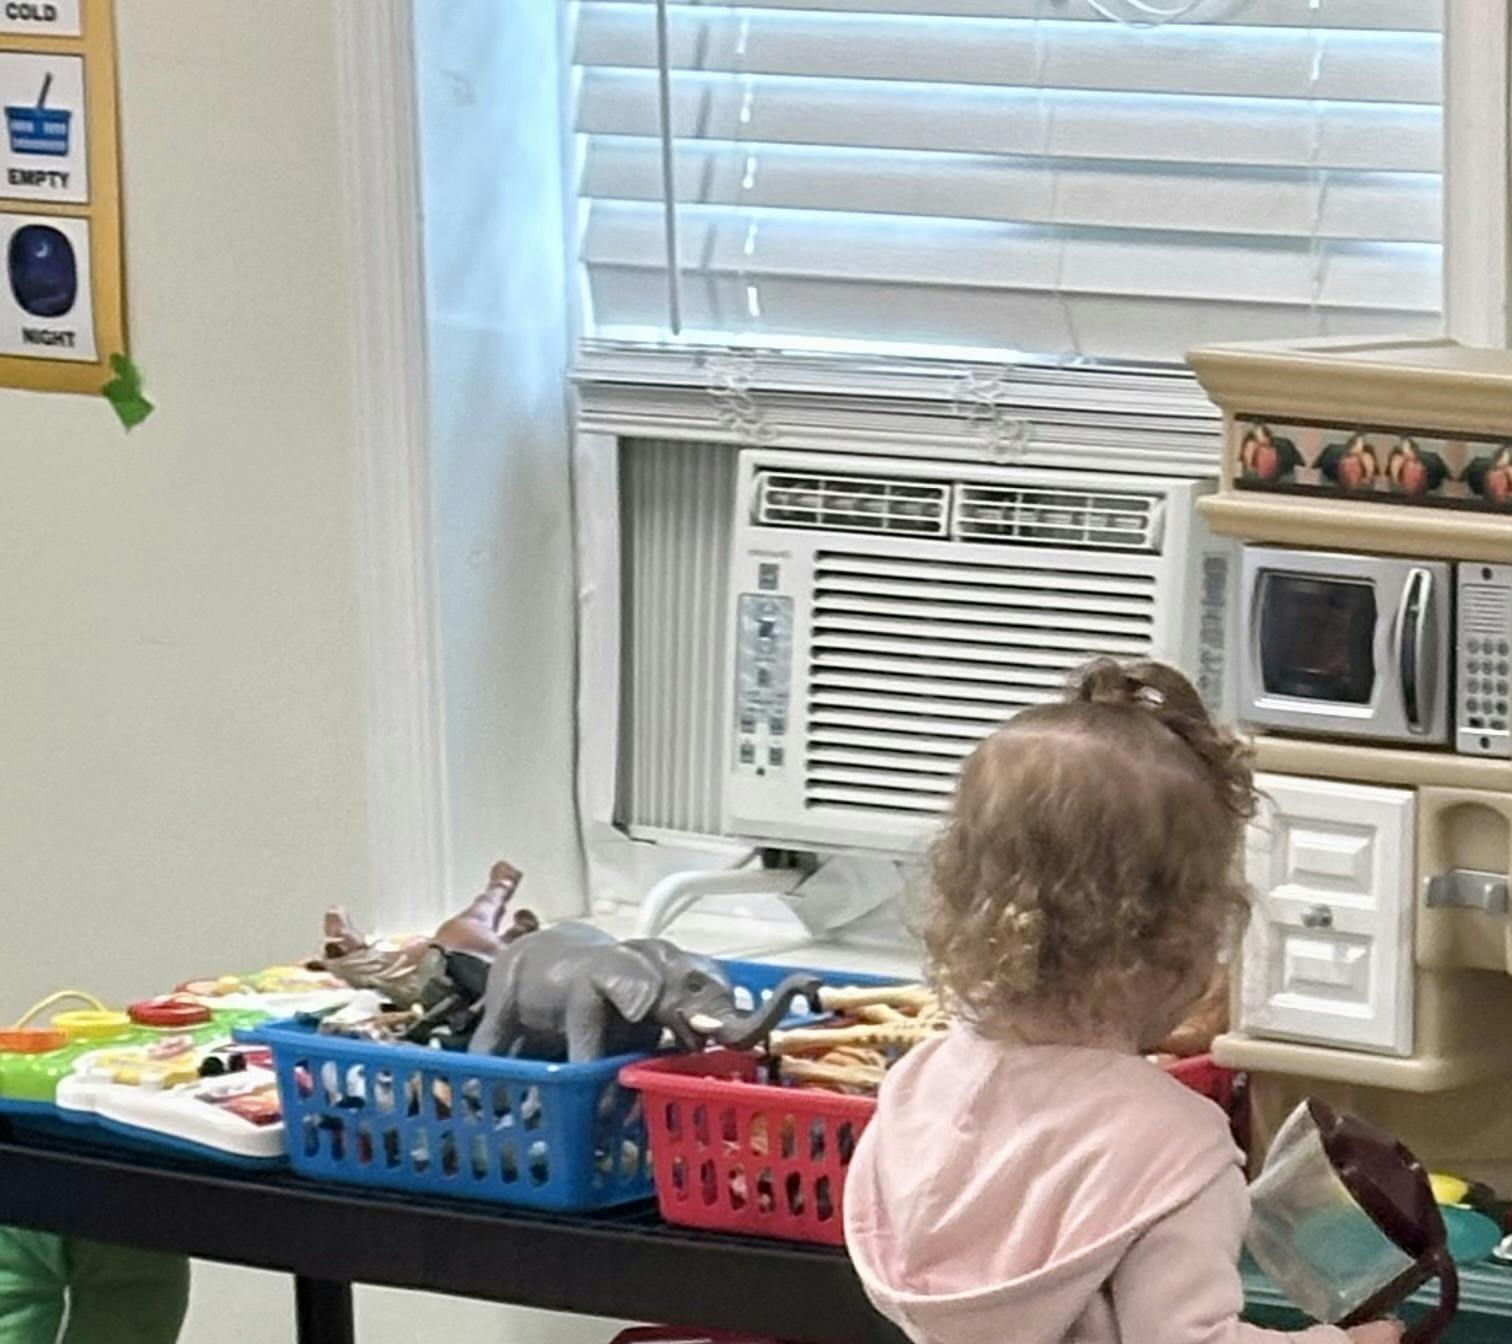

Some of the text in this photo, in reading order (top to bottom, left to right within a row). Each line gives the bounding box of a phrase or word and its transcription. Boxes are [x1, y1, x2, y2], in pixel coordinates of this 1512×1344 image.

[5, 2, 57, 21] COLD
[7, 168, 70, 188] EMPTY
[22, 327, 76, 347] NIGHT
